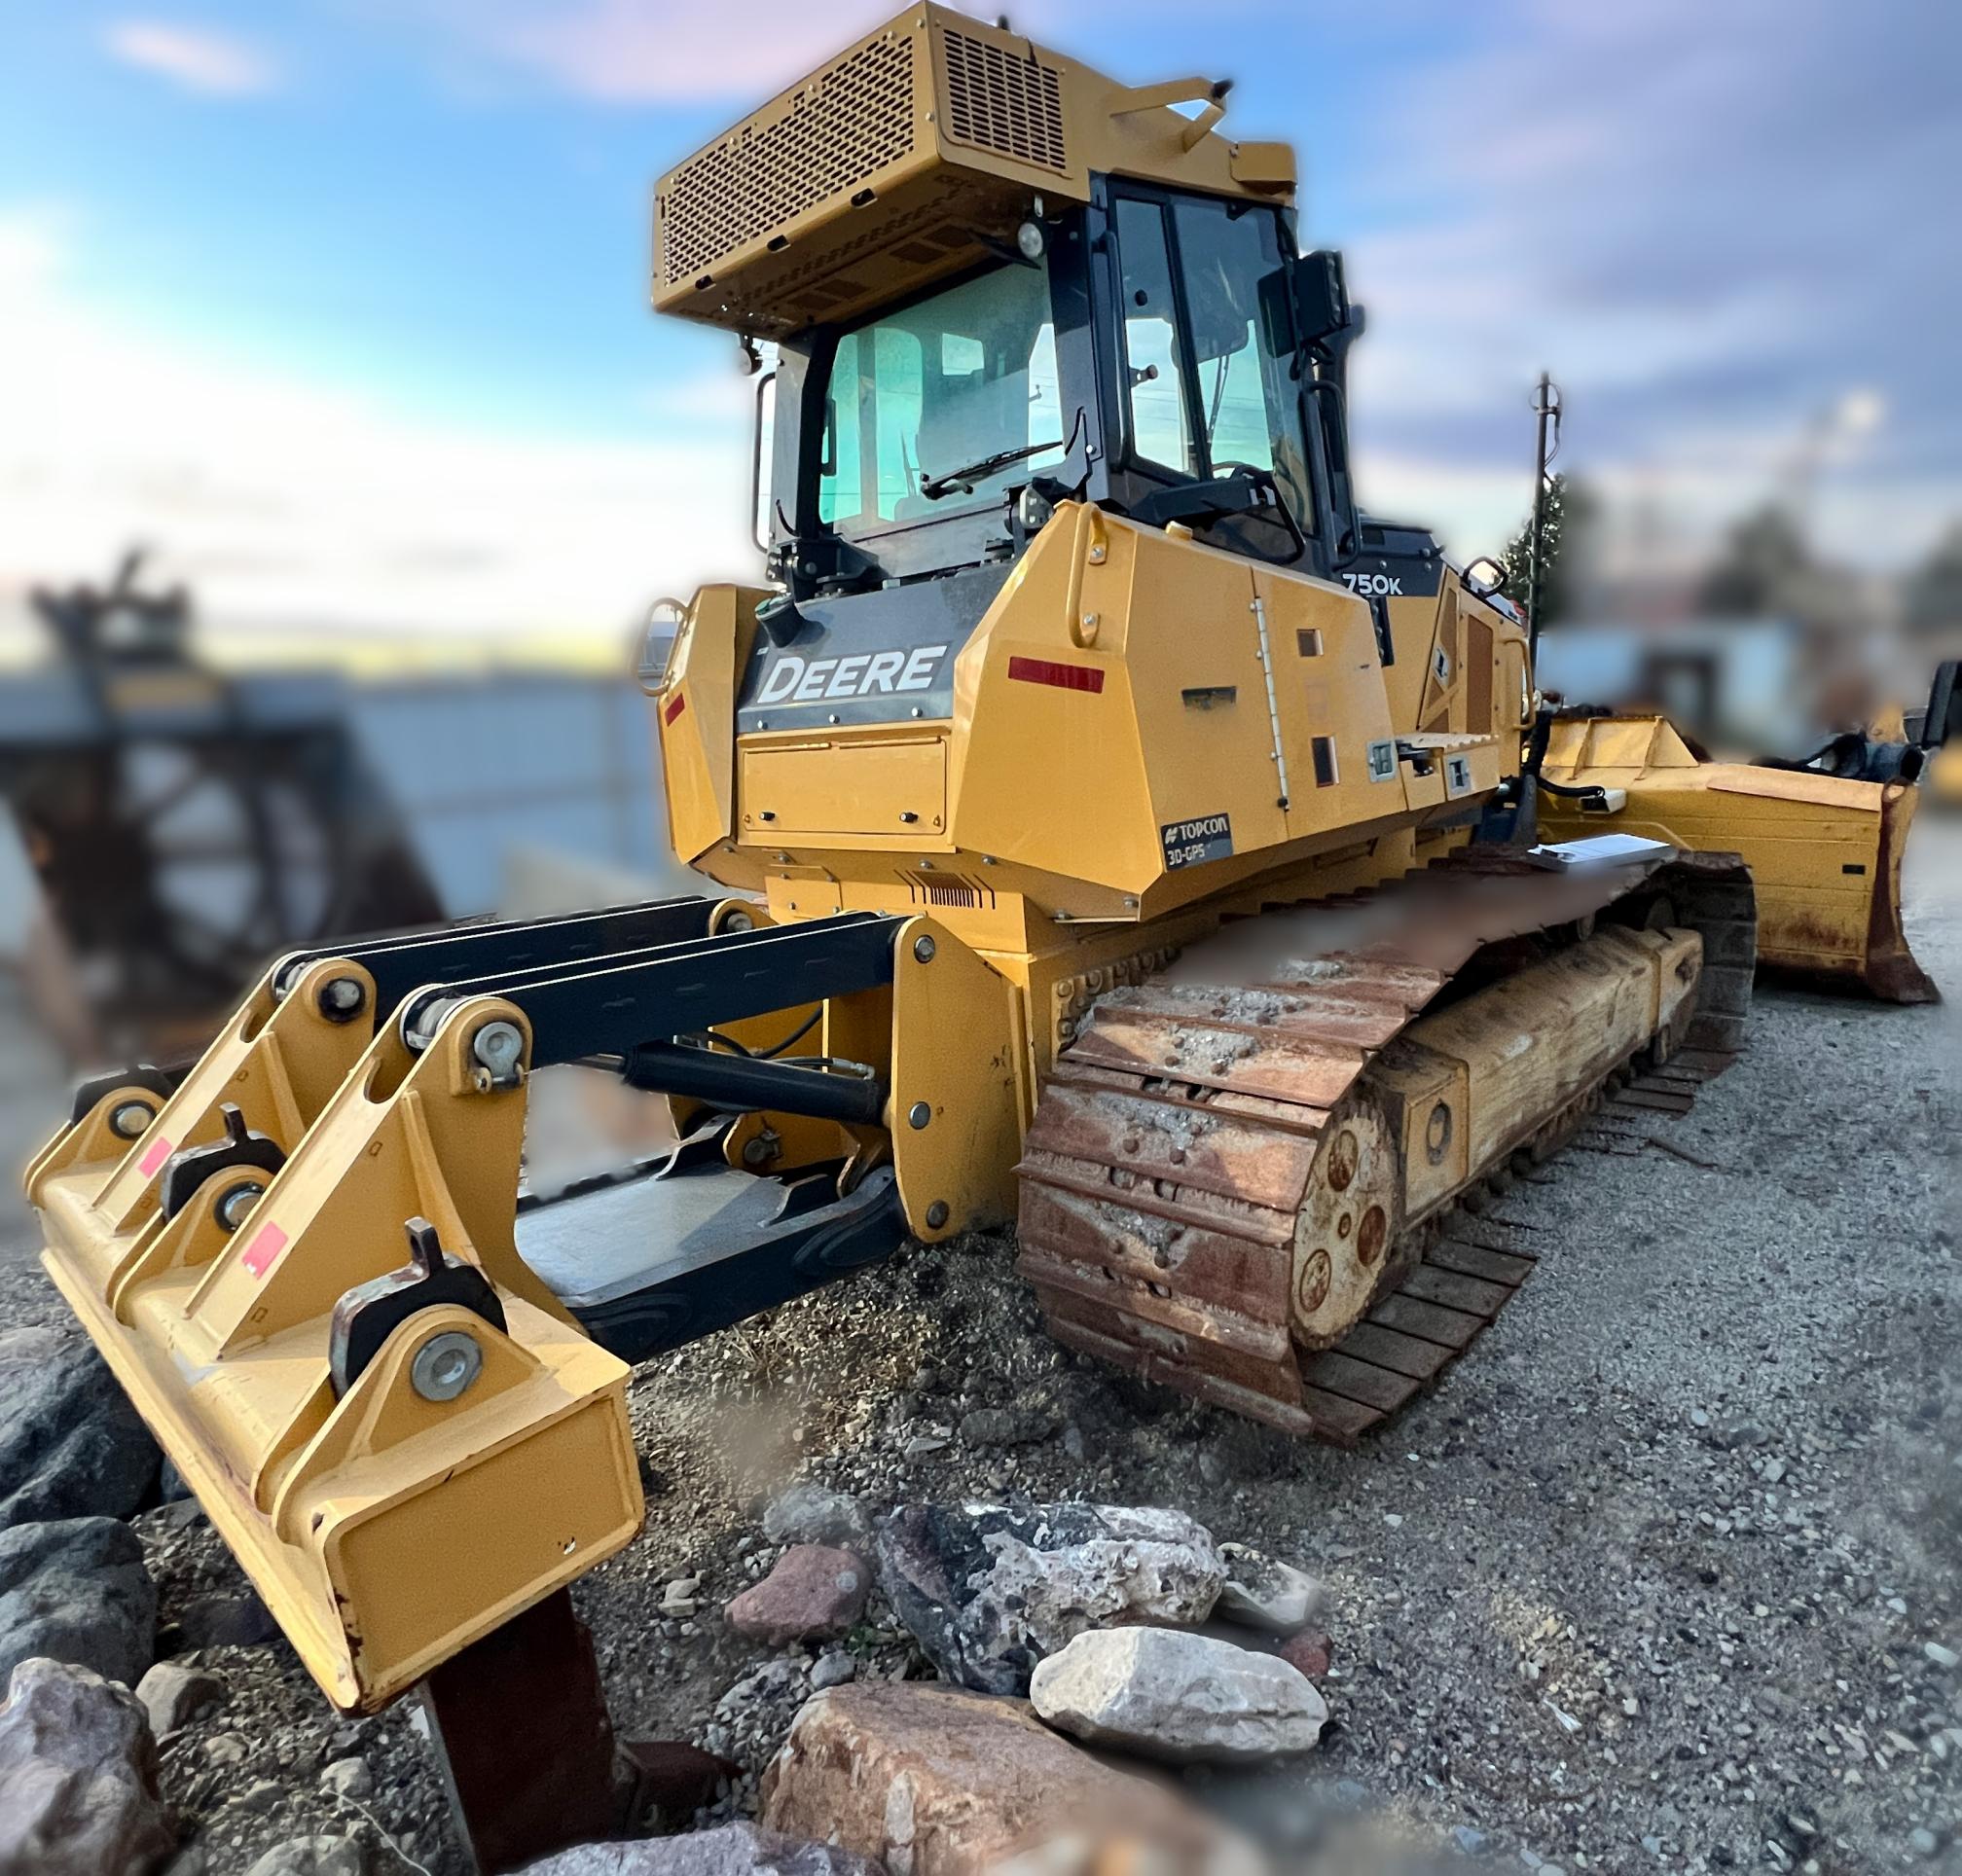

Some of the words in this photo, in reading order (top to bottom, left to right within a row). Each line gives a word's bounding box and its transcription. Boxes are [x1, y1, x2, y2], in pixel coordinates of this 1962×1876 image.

[1342, 573, 1403, 595] 750K
[757, 645, 948, 704] DEERE
[1179, 817, 1228, 841] TOPCON
[1168, 843, 1206, 866] 3D-GPS
